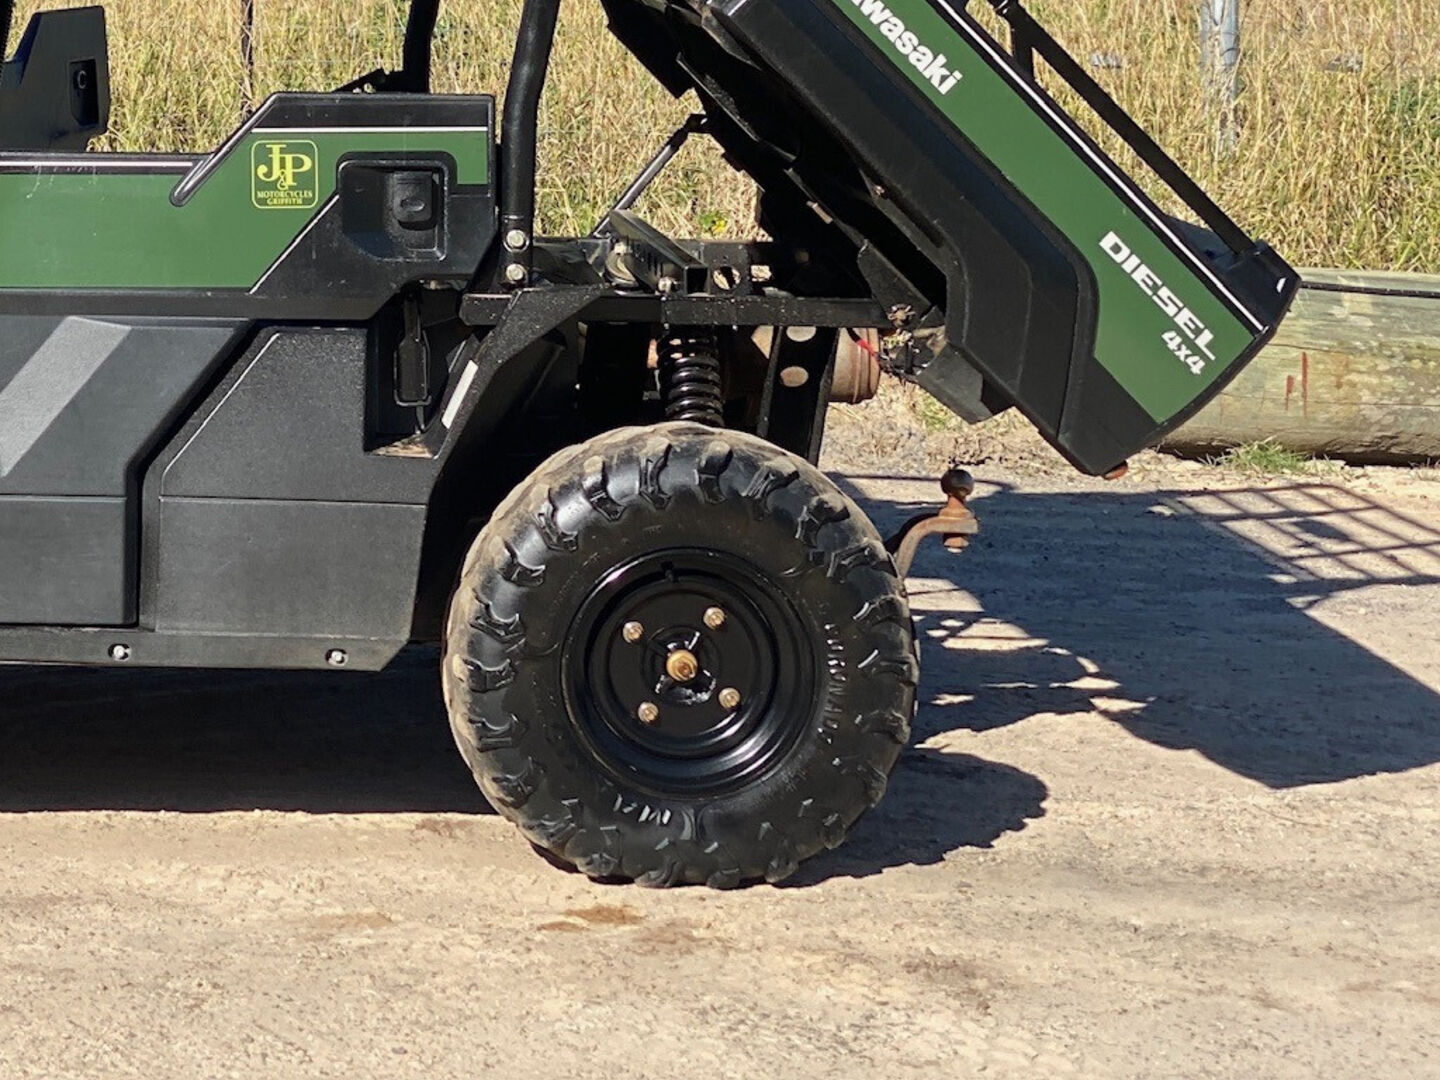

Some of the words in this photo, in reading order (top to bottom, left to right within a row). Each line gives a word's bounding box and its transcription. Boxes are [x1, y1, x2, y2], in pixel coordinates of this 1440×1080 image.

[257, 190, 312, 198] MOTORCYCLES
[1098, 231, 1216, 360] DIESEL
[1161, 330, 1206, 375] 4x4
